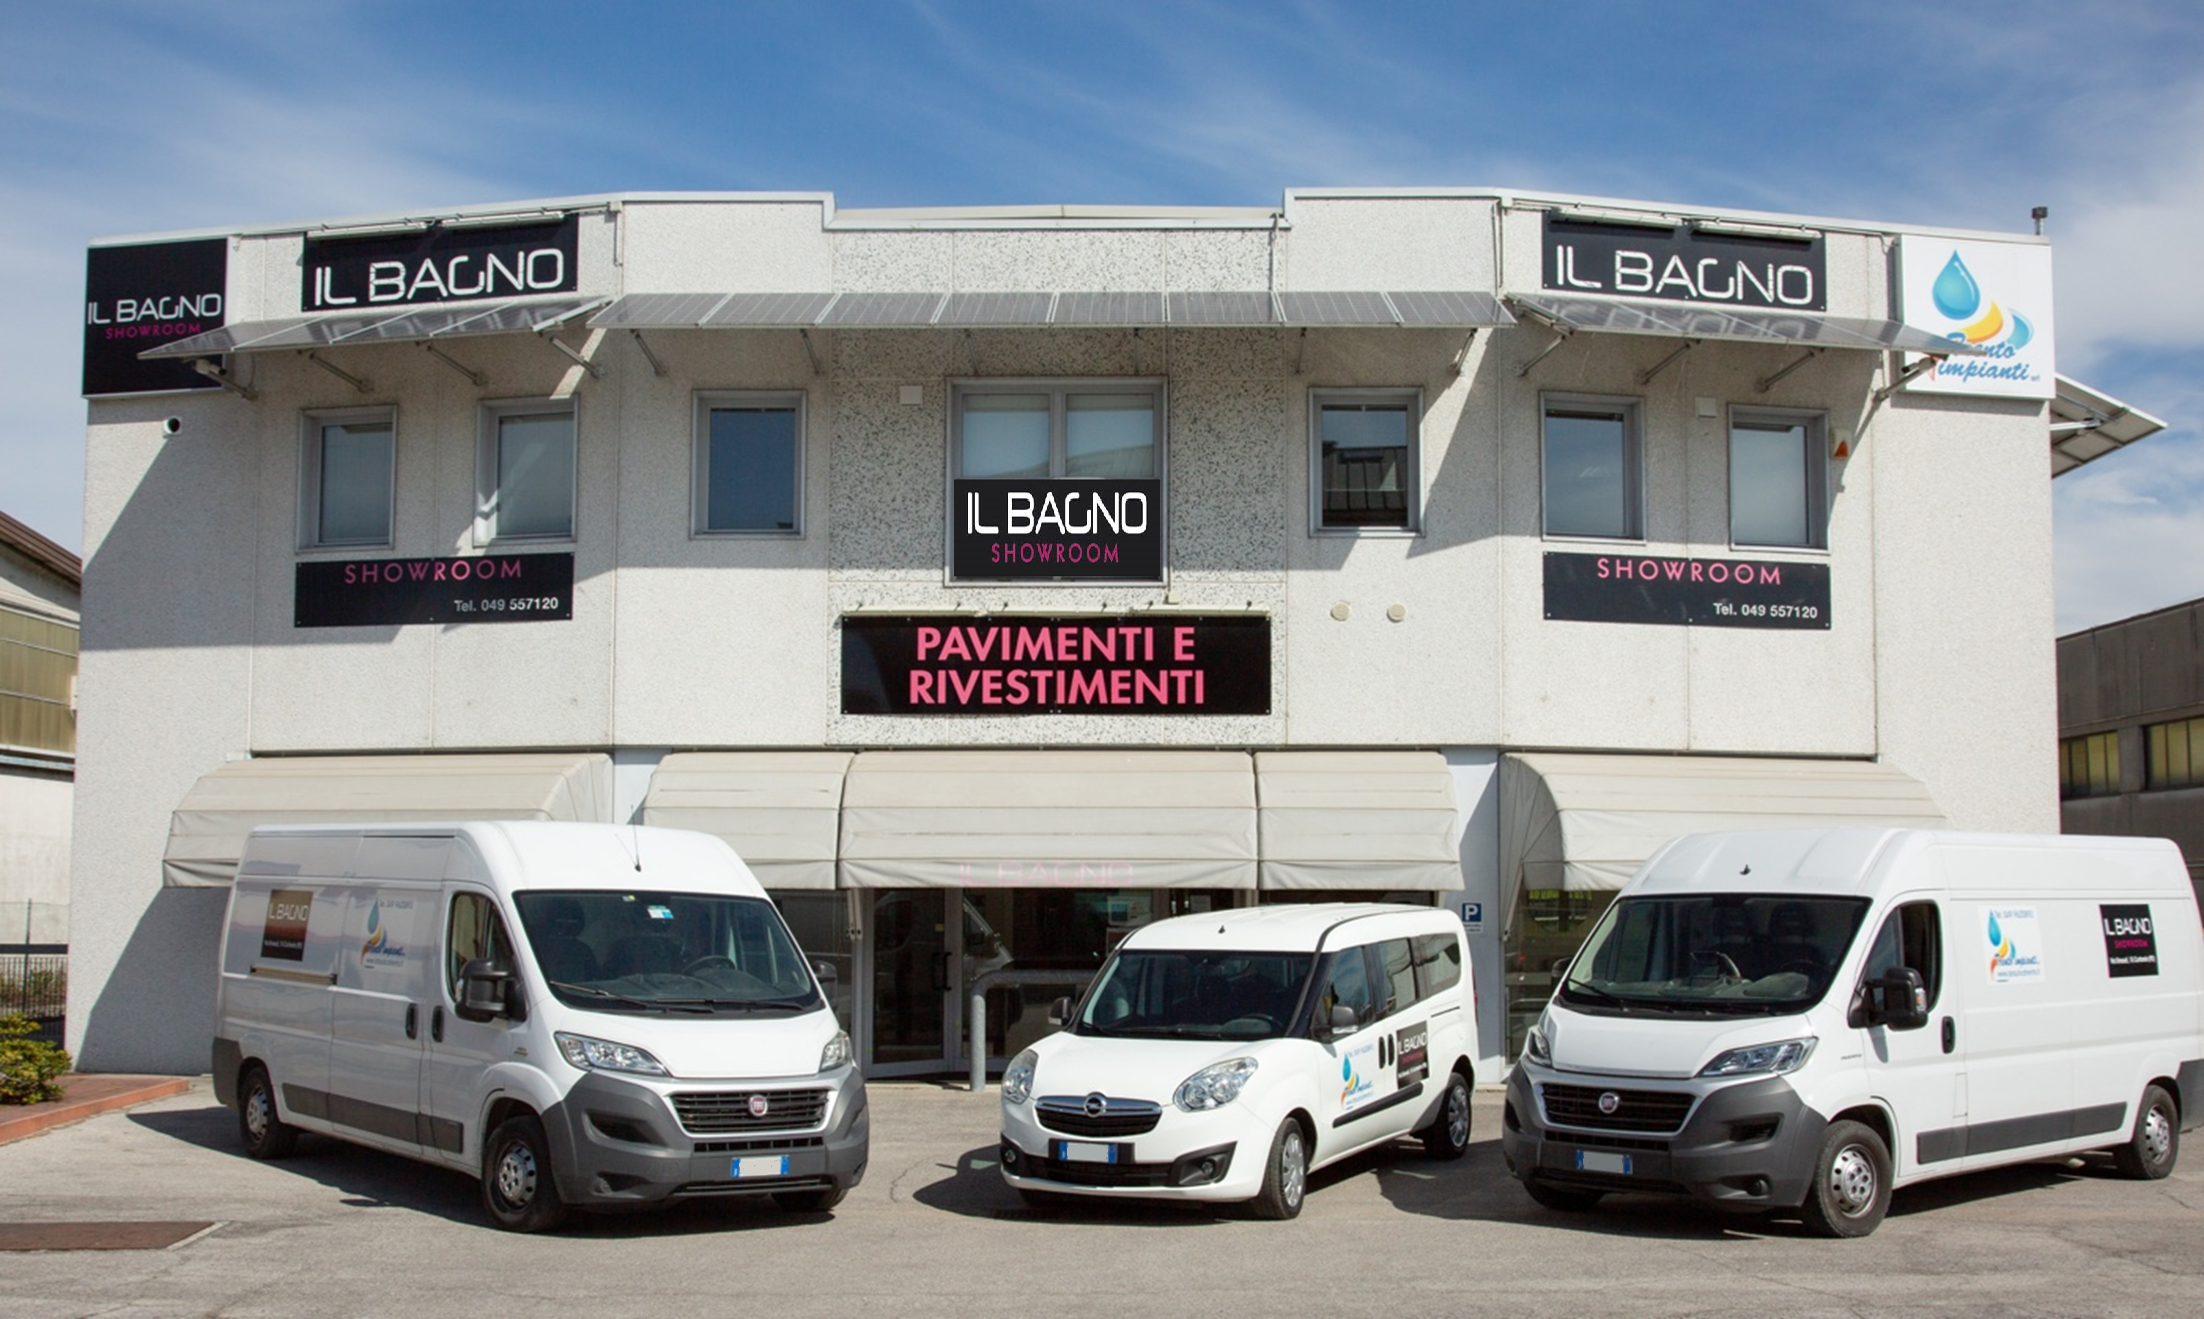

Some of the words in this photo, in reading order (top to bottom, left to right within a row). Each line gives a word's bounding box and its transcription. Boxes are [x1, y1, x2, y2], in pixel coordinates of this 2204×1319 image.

[314, 266, 357, 306] IL
[369, 248, 564, 302] BAGNO
[1557, 245, 1602, 288] IL
[1615, 250, 1813, 305] BAGNO
[87, 302, 111, 325] IL
[116, 293, 221, 322] BAGNO
[105, 323, 200, 340] SHOWROOM
[1938, 360, 2029, 383] impianti
[967, 491, 999, 535] IL
[1007, 491, 1148, 535] BAGNO
[991, 543, 1119, 563] SHOWROOM
[344, 559, 521, 584] SHOWROOM
[1597, 558, 1781, 585] SHOWROOM
[454, 600, 476, 612] Tel.
[481, 599, 505, 611] 049
[509, 597, 559, 610] 557120
[1713, 603, 1737, 616] Tel.
[1741, 604, 1766, 617] 049
[1770, 605, 1818, 619] 557120
[917, 627, 1154, 661] PAVIMENTI
[1174, 627, 1195, 660] E
[909, 669, 1204, 704] RIVESTIMENTI
[998, 862, 1133, 885] BAGNO
[277, 903, 309, 921] BAGNO
[1465, 904, 1478, 921] P
[2114, 917, 2152, 935] BAGNO
[1404, 1032, 1427, 1053] BAGNO
